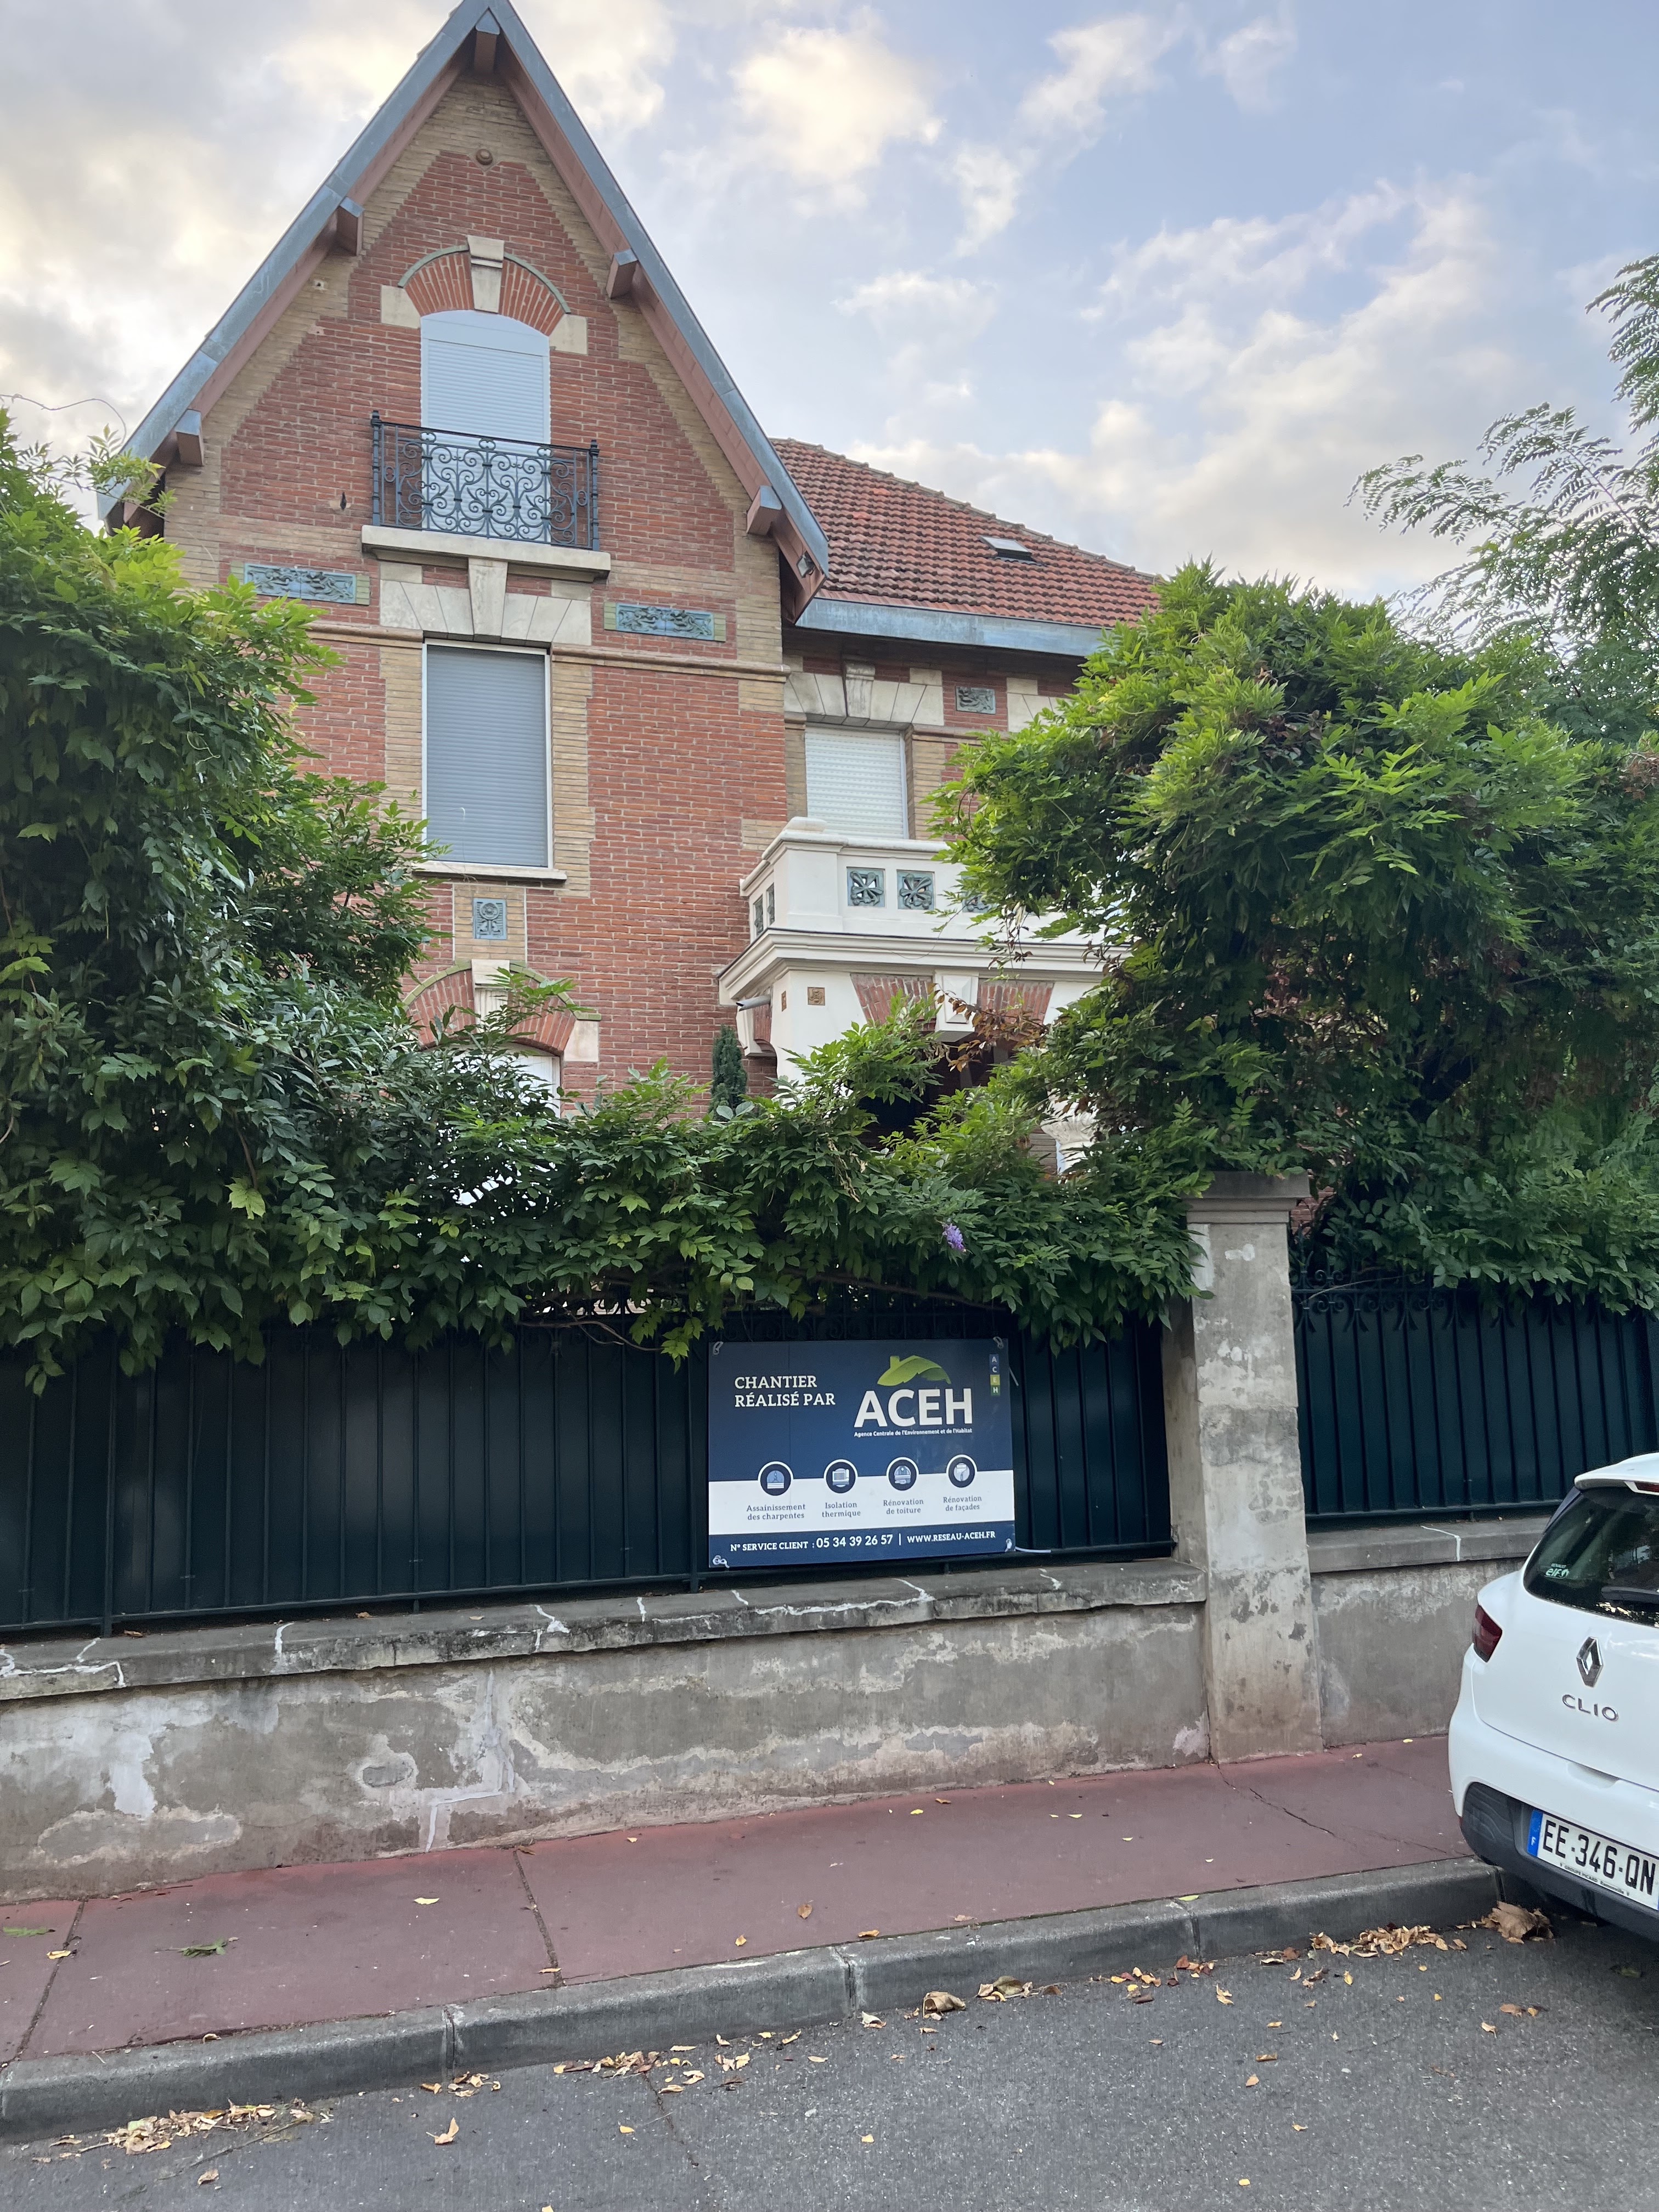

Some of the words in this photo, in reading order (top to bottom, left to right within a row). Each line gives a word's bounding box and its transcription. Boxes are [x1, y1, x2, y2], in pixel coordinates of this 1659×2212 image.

[735, 1375, 817, 1389] CHANTIER
[735, 1391, 799, 1407] RÉALISÉ
[803, 1393, 836, 1406] PAR
[854, 1388, 973, 1427] ACEH
[883, 1498, 924, 1506] Rénovation
[943, 1495, 982, 1503] Rénovation
[746, 1503, 806, 1512] Assainissement
[955, 1503, 980, 1512] façades
[762, 1512, 805, 1521] charpentes
[822, 1510, 861, 1518] thermique
[742, 1542, 777, 1551] SERVICE
[779, 1541, 808, 1550] CLIENT
[816, 1537, 830, 1548] 05
[833, 1537, 846, 1547] 34
[849, 1536, 862, 1547] 39
[865, 1535, 878, 1545] 26
[881, 1534, 893, 1545] 57
[907, 1531, 996, 1544] WWW.RESEAU-ACEH.FR
[1545, 1568, 1562, 1577] elf
[1562, 1694, 1619, 1722] CLIO
[1531, 1836, 1536, 1846] F
[1543, 1819, 1656, 1895] EE-346-QN
